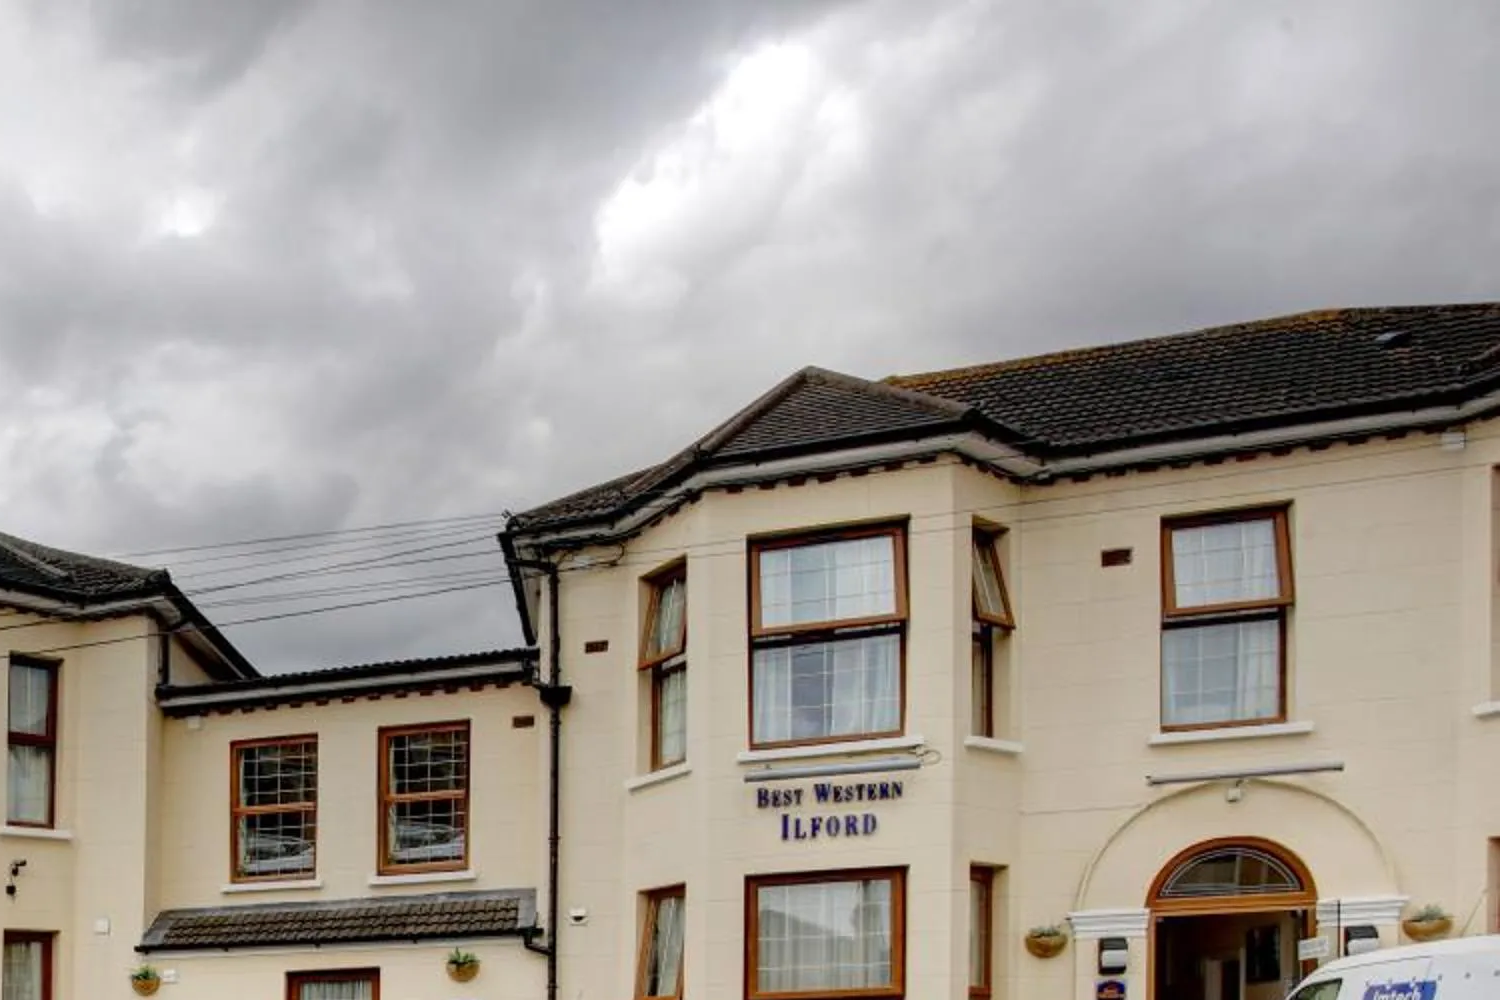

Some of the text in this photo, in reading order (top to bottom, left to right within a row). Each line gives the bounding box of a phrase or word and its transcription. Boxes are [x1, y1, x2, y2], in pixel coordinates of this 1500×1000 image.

[757, 782, 903, 808] BEST WESTERN
[781, 813, 877, 840] ILFORD
